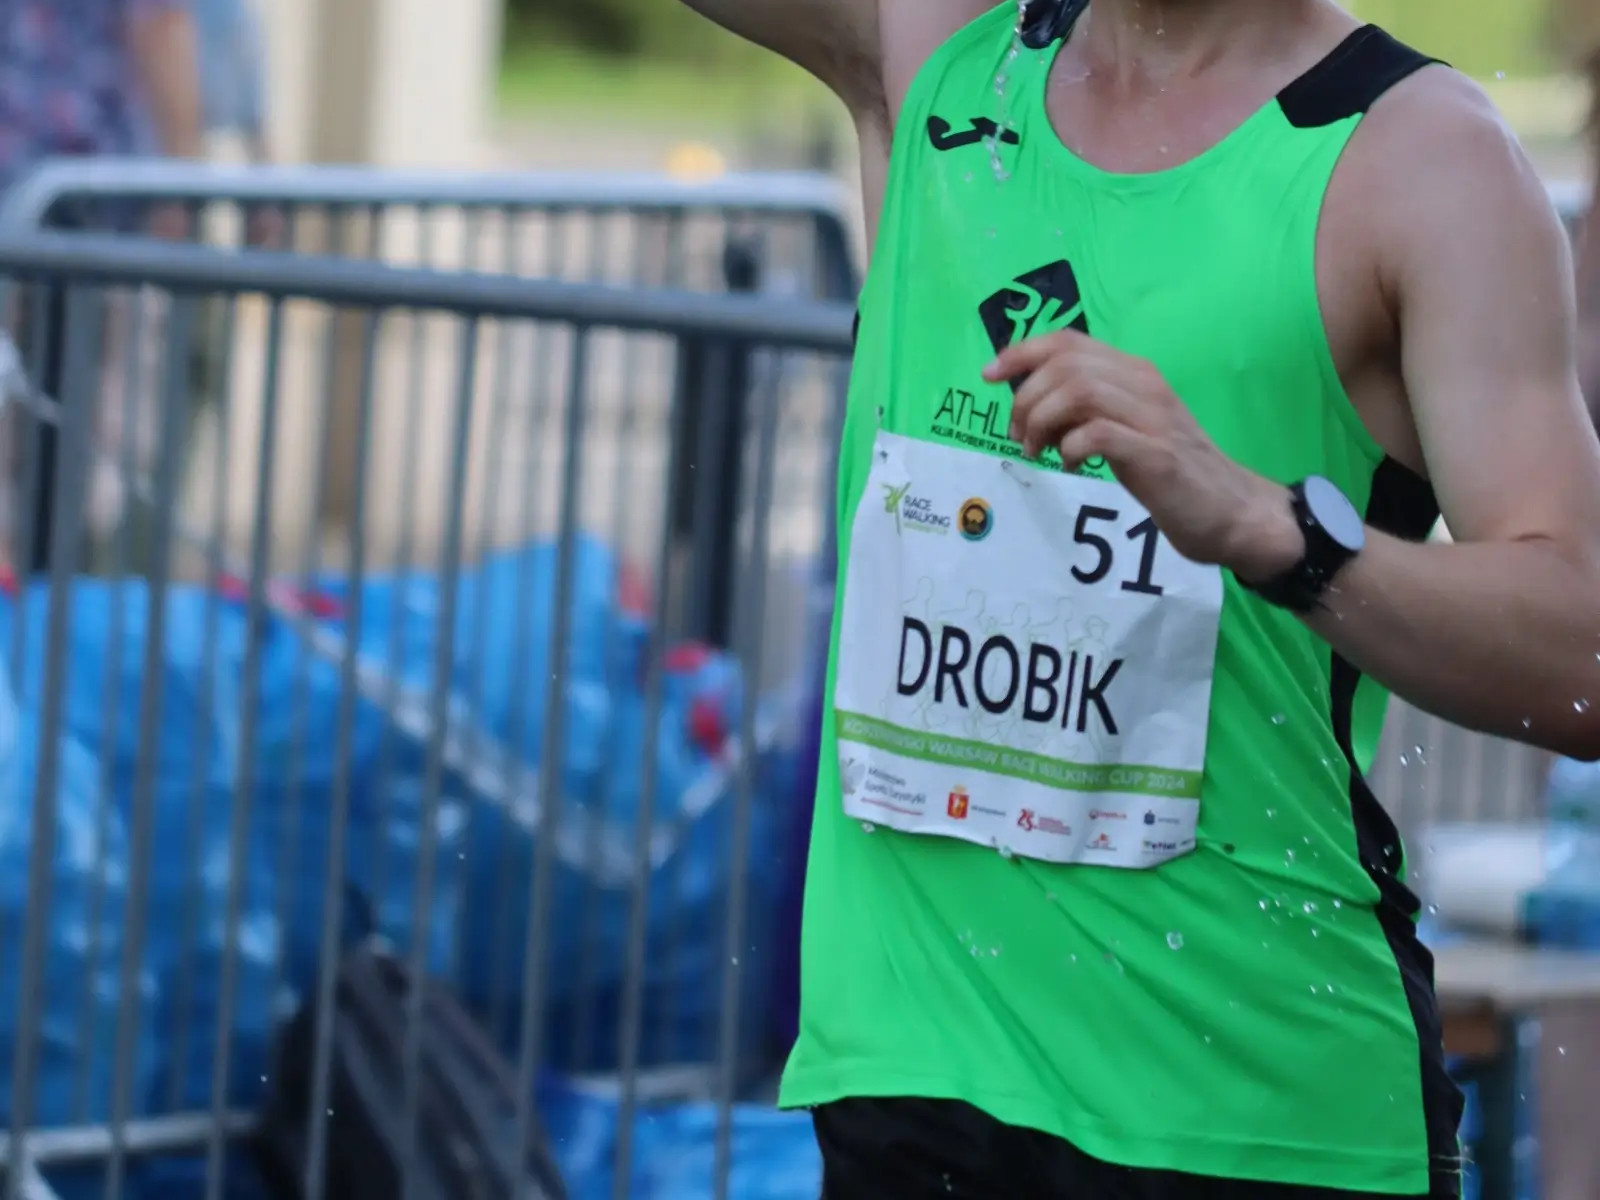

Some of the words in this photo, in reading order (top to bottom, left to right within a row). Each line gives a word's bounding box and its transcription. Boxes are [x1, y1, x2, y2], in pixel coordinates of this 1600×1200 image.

[955, 431, 997, 452] ROBERTA
[903, 495, 932, 512] RACE
[903, 507, 951, 529] WALKING
[1070, 504, 1163, 596] 51
[897, 616, 1124, 735] DROBIK
[1039, 761, 1106, 785] WALKING
[1108, 769, 1145, 786] CUP
[1147, 772, 1186, 790] 2024
